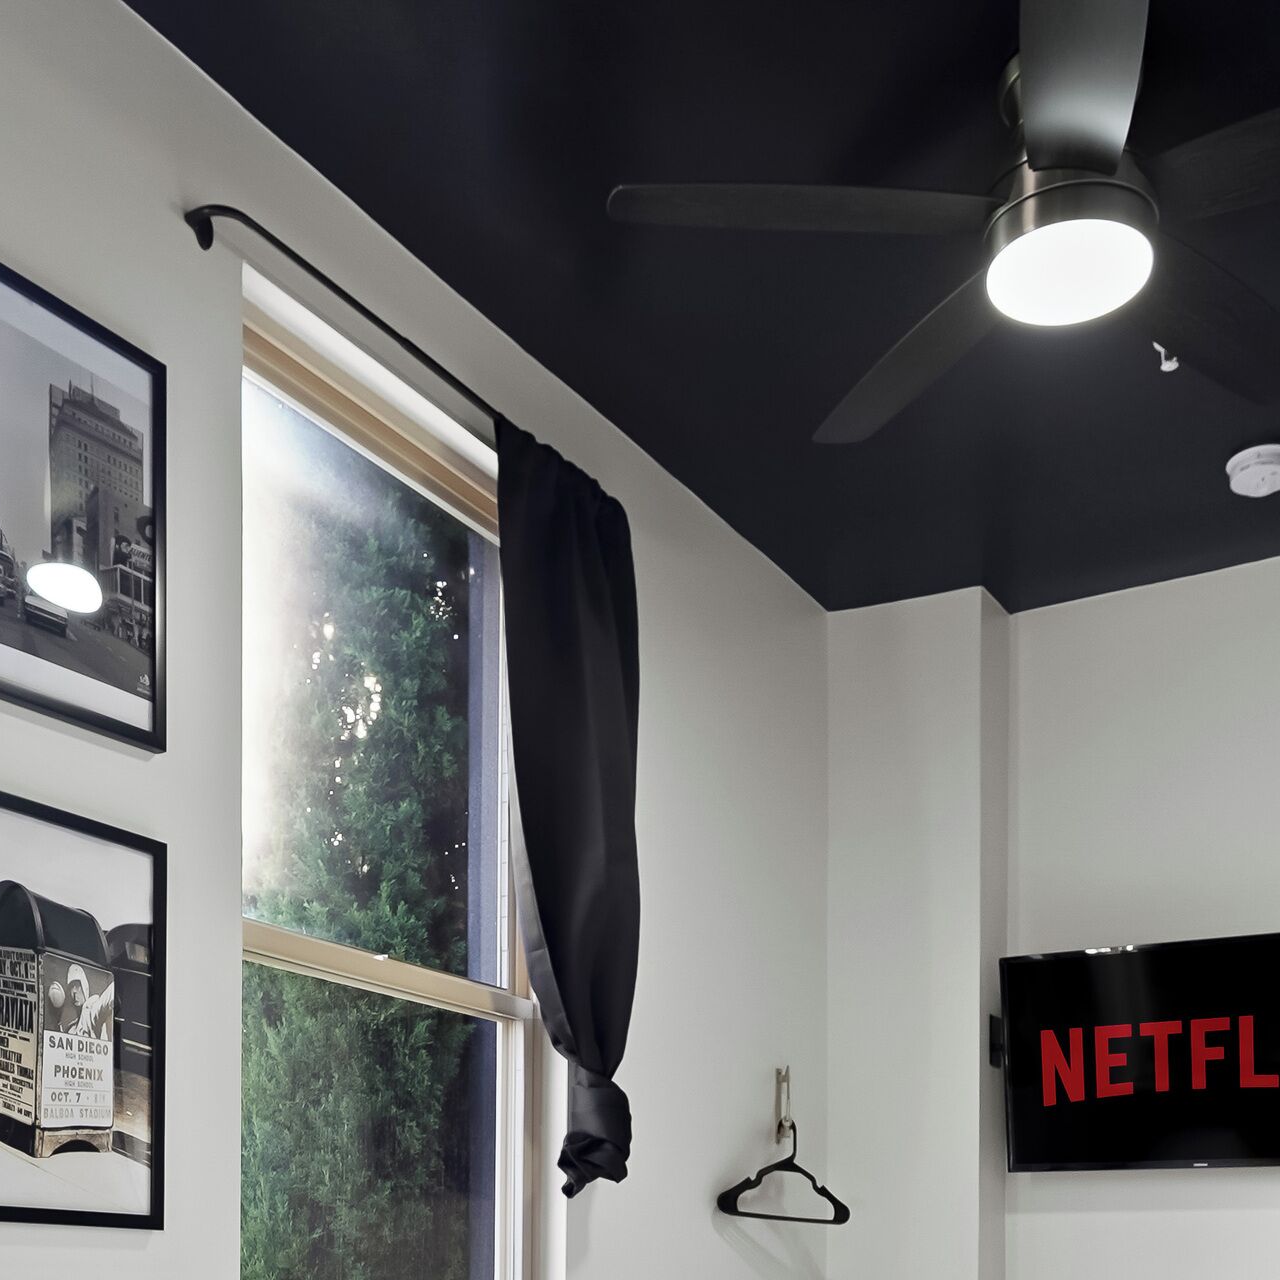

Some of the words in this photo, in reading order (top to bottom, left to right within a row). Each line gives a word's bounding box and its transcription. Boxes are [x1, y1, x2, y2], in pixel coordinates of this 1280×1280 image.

[48, 1035, 73, 1051] SAN
[78, 1040, 108, 1056] DIEGO
[78, 1054, 93, 1062] SCHOOL
[54, 1065, 103, 1081] PHOENIX
[50, 1091, 71, 1103] OCT.
[76, 1092, 81, 1103] 7
[43, 1108, 74, 1119] BALBOA
[80, 1108, 111, 1119] STADIUM
